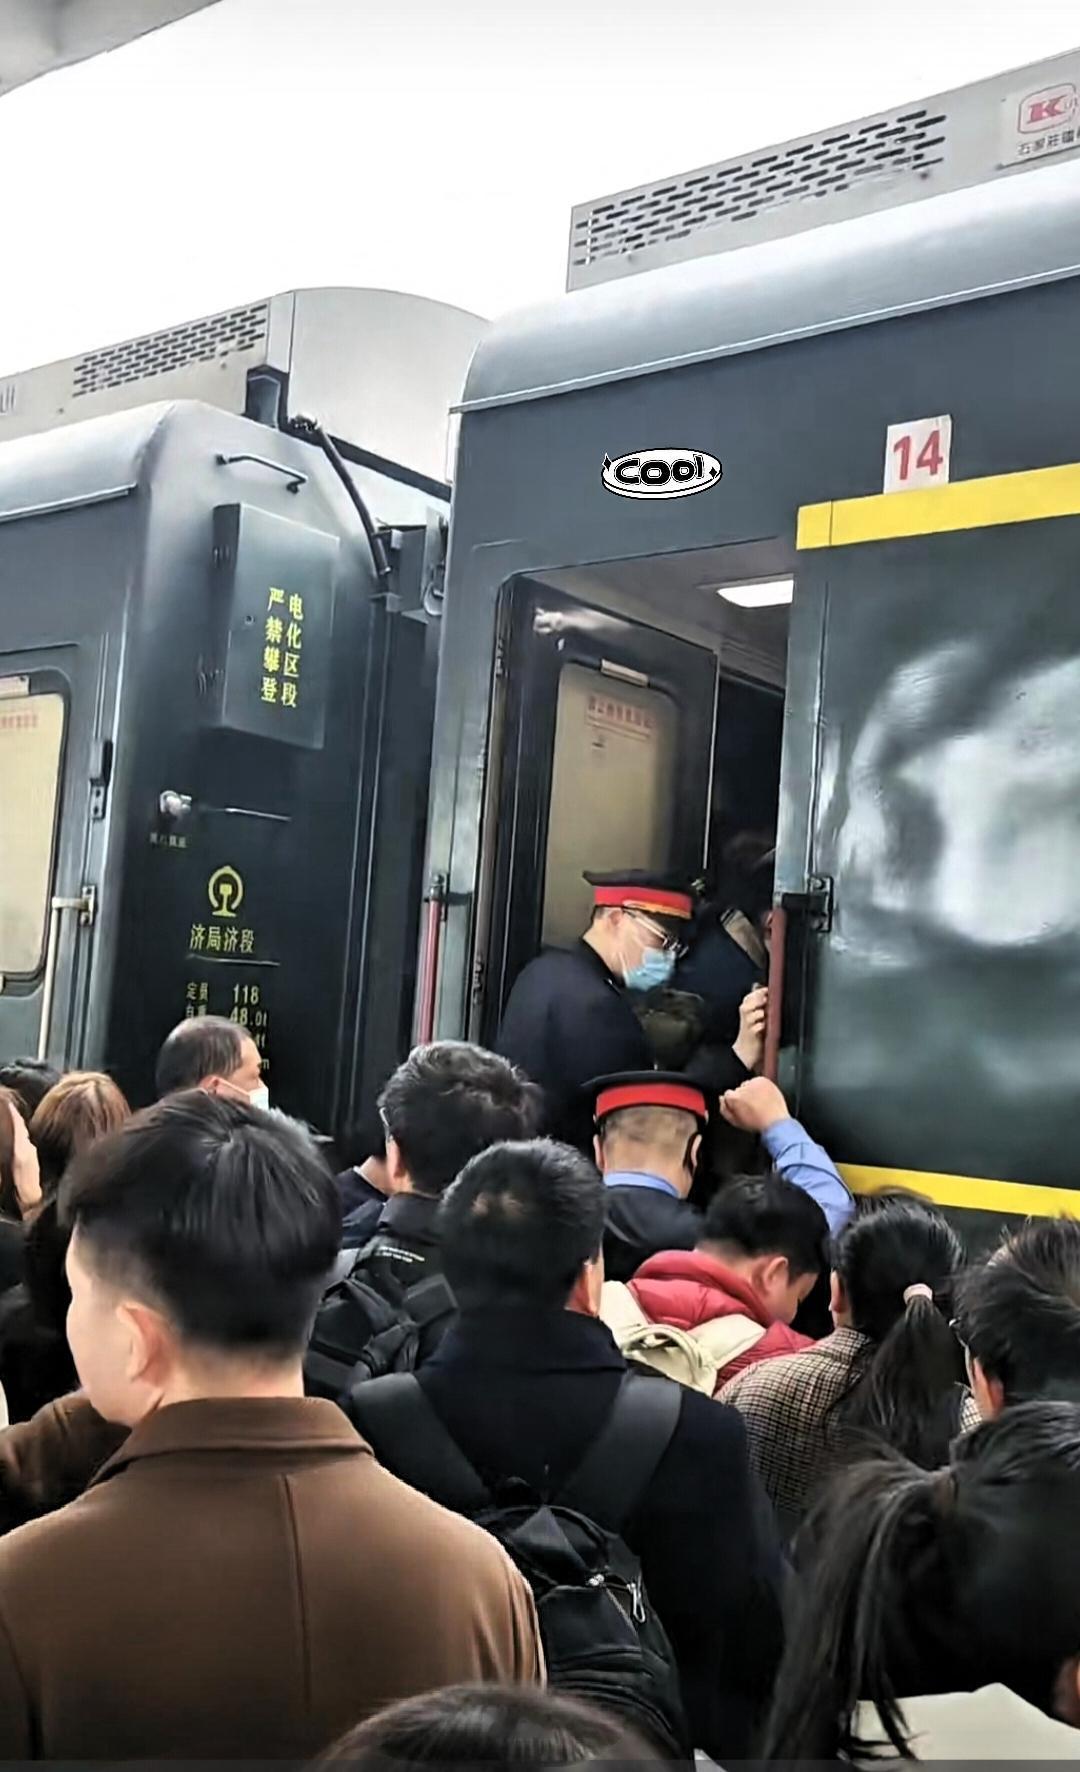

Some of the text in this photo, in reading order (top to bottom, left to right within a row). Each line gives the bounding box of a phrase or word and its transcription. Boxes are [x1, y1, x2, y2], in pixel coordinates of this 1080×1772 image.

[893, 429, 943, 480] 14
[261, 587, 285, 702] 严禁攀登
[281, 594, 303, 708] 电化区段
[189, 923, 255, 953] 济局济段
[233, 983, 259, 1004] 118
